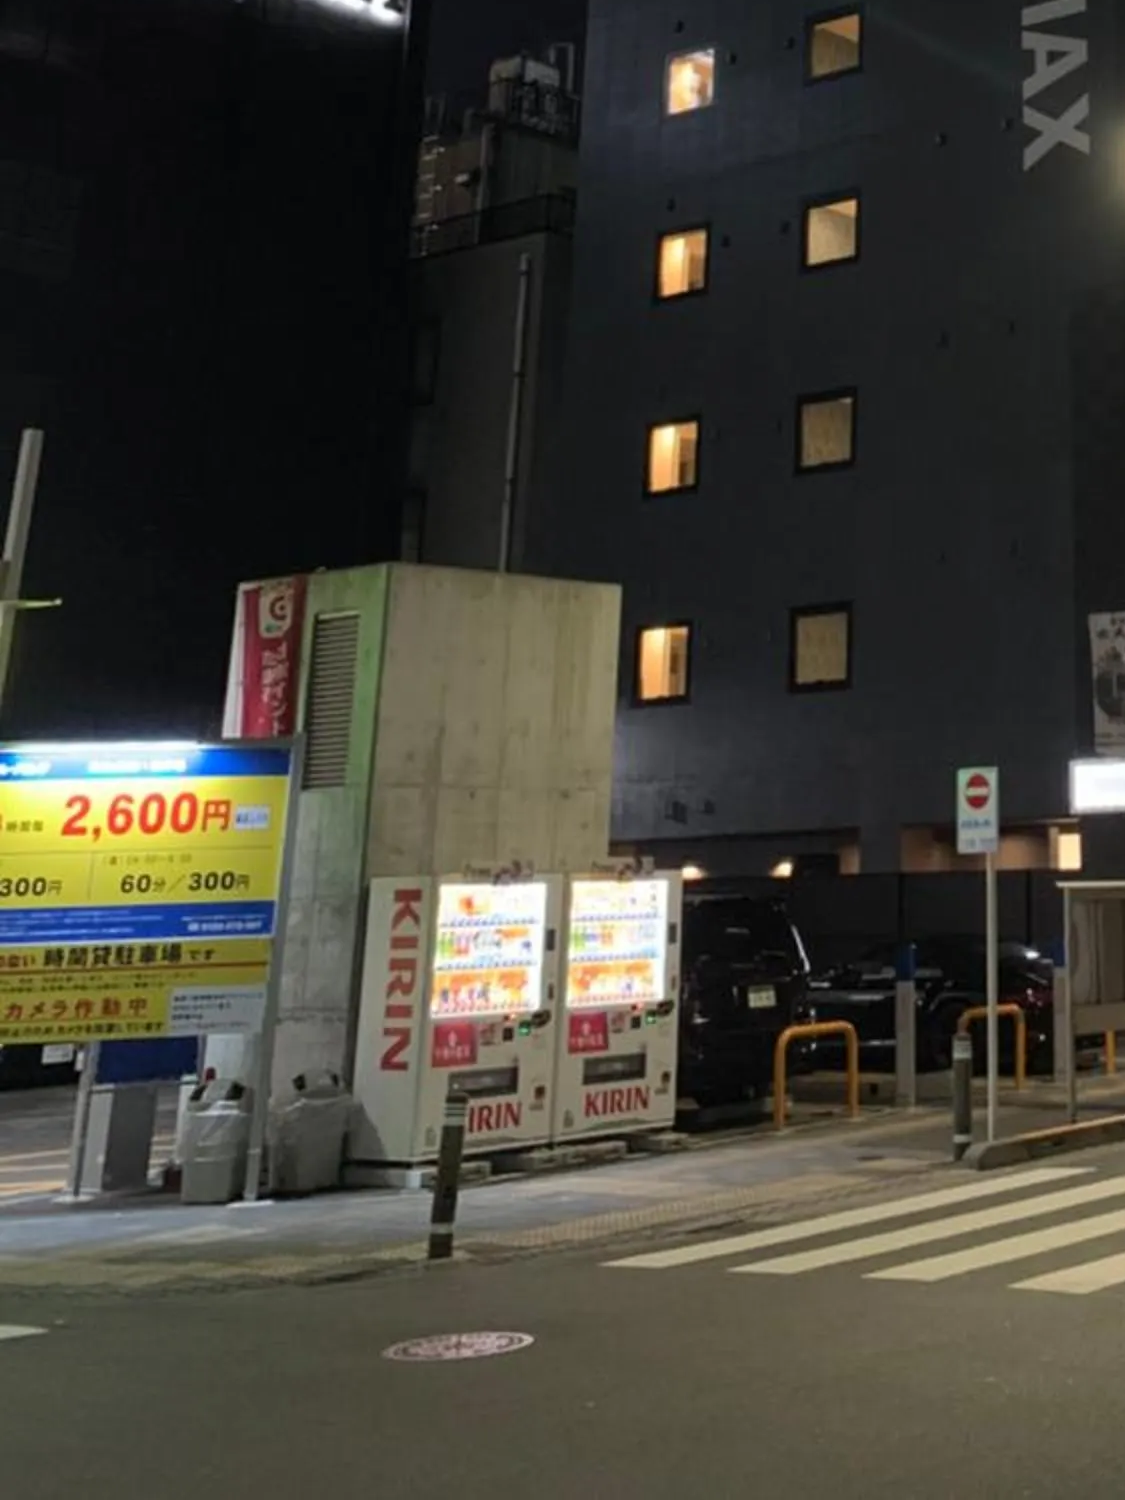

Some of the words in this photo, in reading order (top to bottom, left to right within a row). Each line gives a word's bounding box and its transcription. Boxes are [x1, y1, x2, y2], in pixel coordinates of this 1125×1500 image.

[60, 792, 232, 843] 2,600円
[379, 888, 423, 1071] KIRIN
[467, 1102, 523, 1133] IRIN
[583, 1086, 650, 1117] KIRIN
